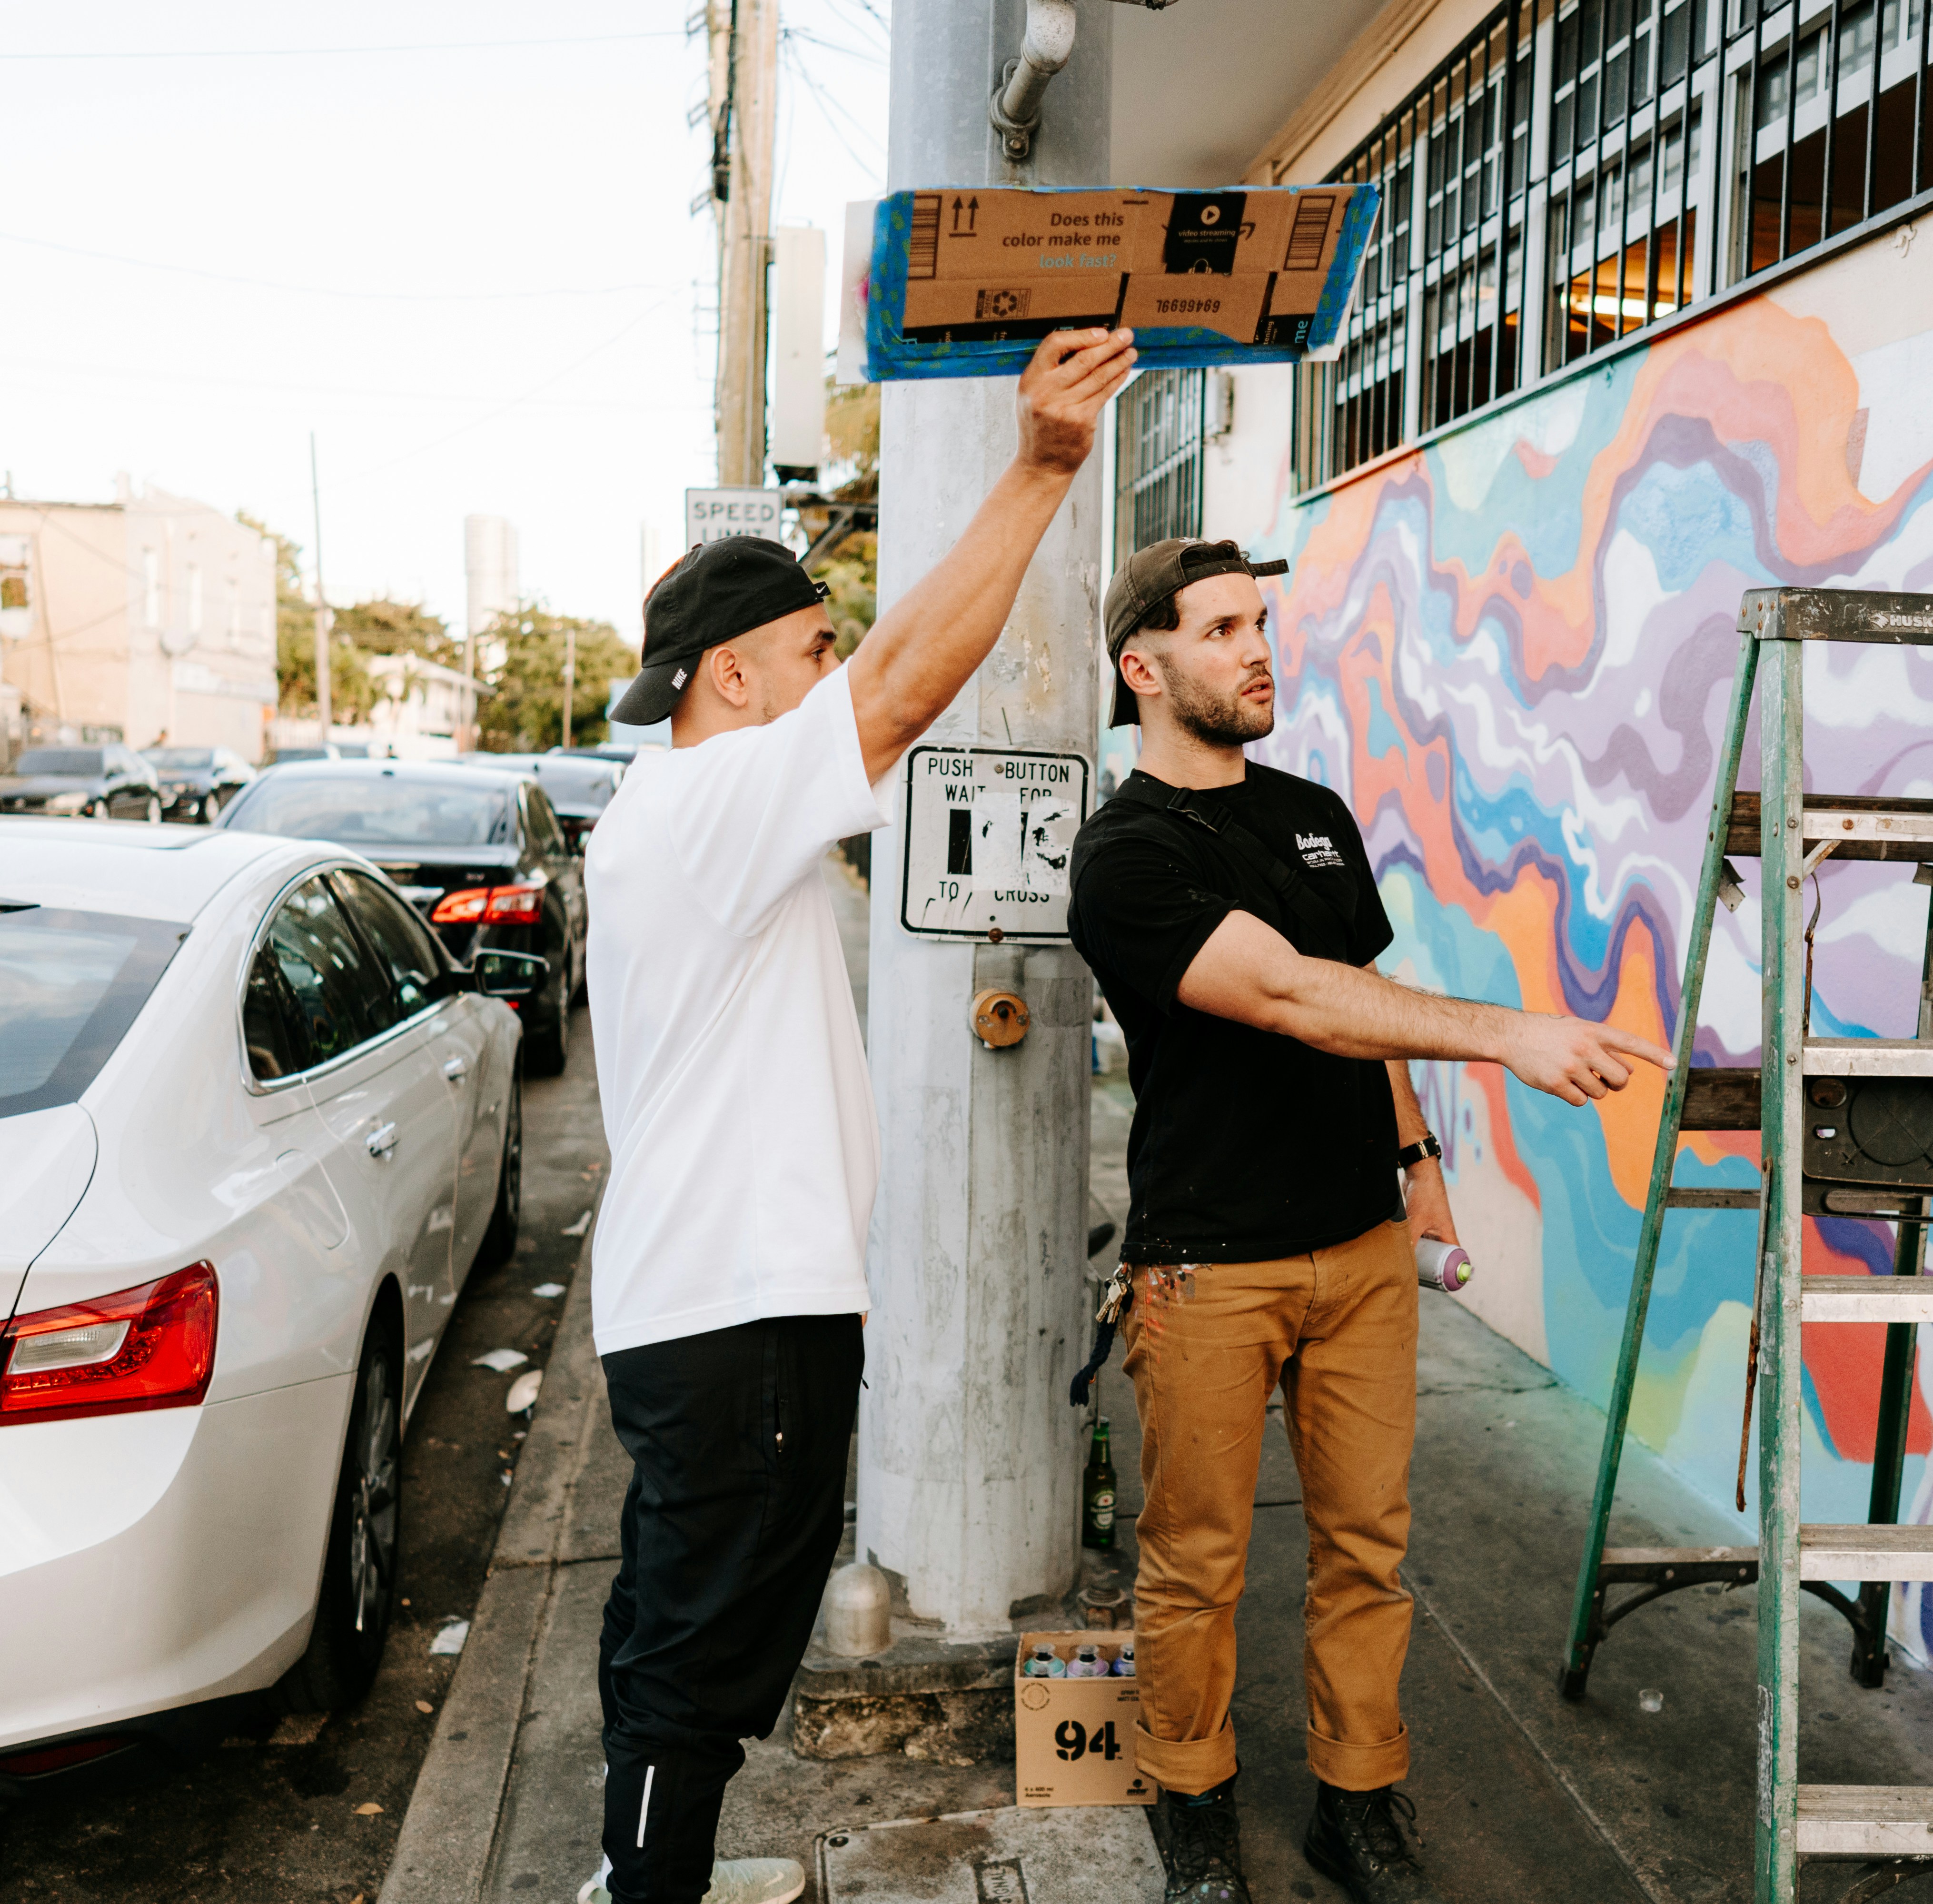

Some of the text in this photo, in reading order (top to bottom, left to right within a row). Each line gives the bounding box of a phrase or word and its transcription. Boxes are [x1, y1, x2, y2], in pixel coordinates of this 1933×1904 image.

[1051, 212, 1124, 226] Does this
[1002, 232, 1121, 247] color make me
[1199, 228, 1236, 238] streaming
[1039, 253, 1117, 268] look fast?
[694, 502, 774, 522] SPEED
[672, 668, 688, 690] NIKE
[928, 757, 1069, 783] PUSH BUTTON
[939, 881, 959, 900] TO
[1054, 1720, 1120, 1761] 94
